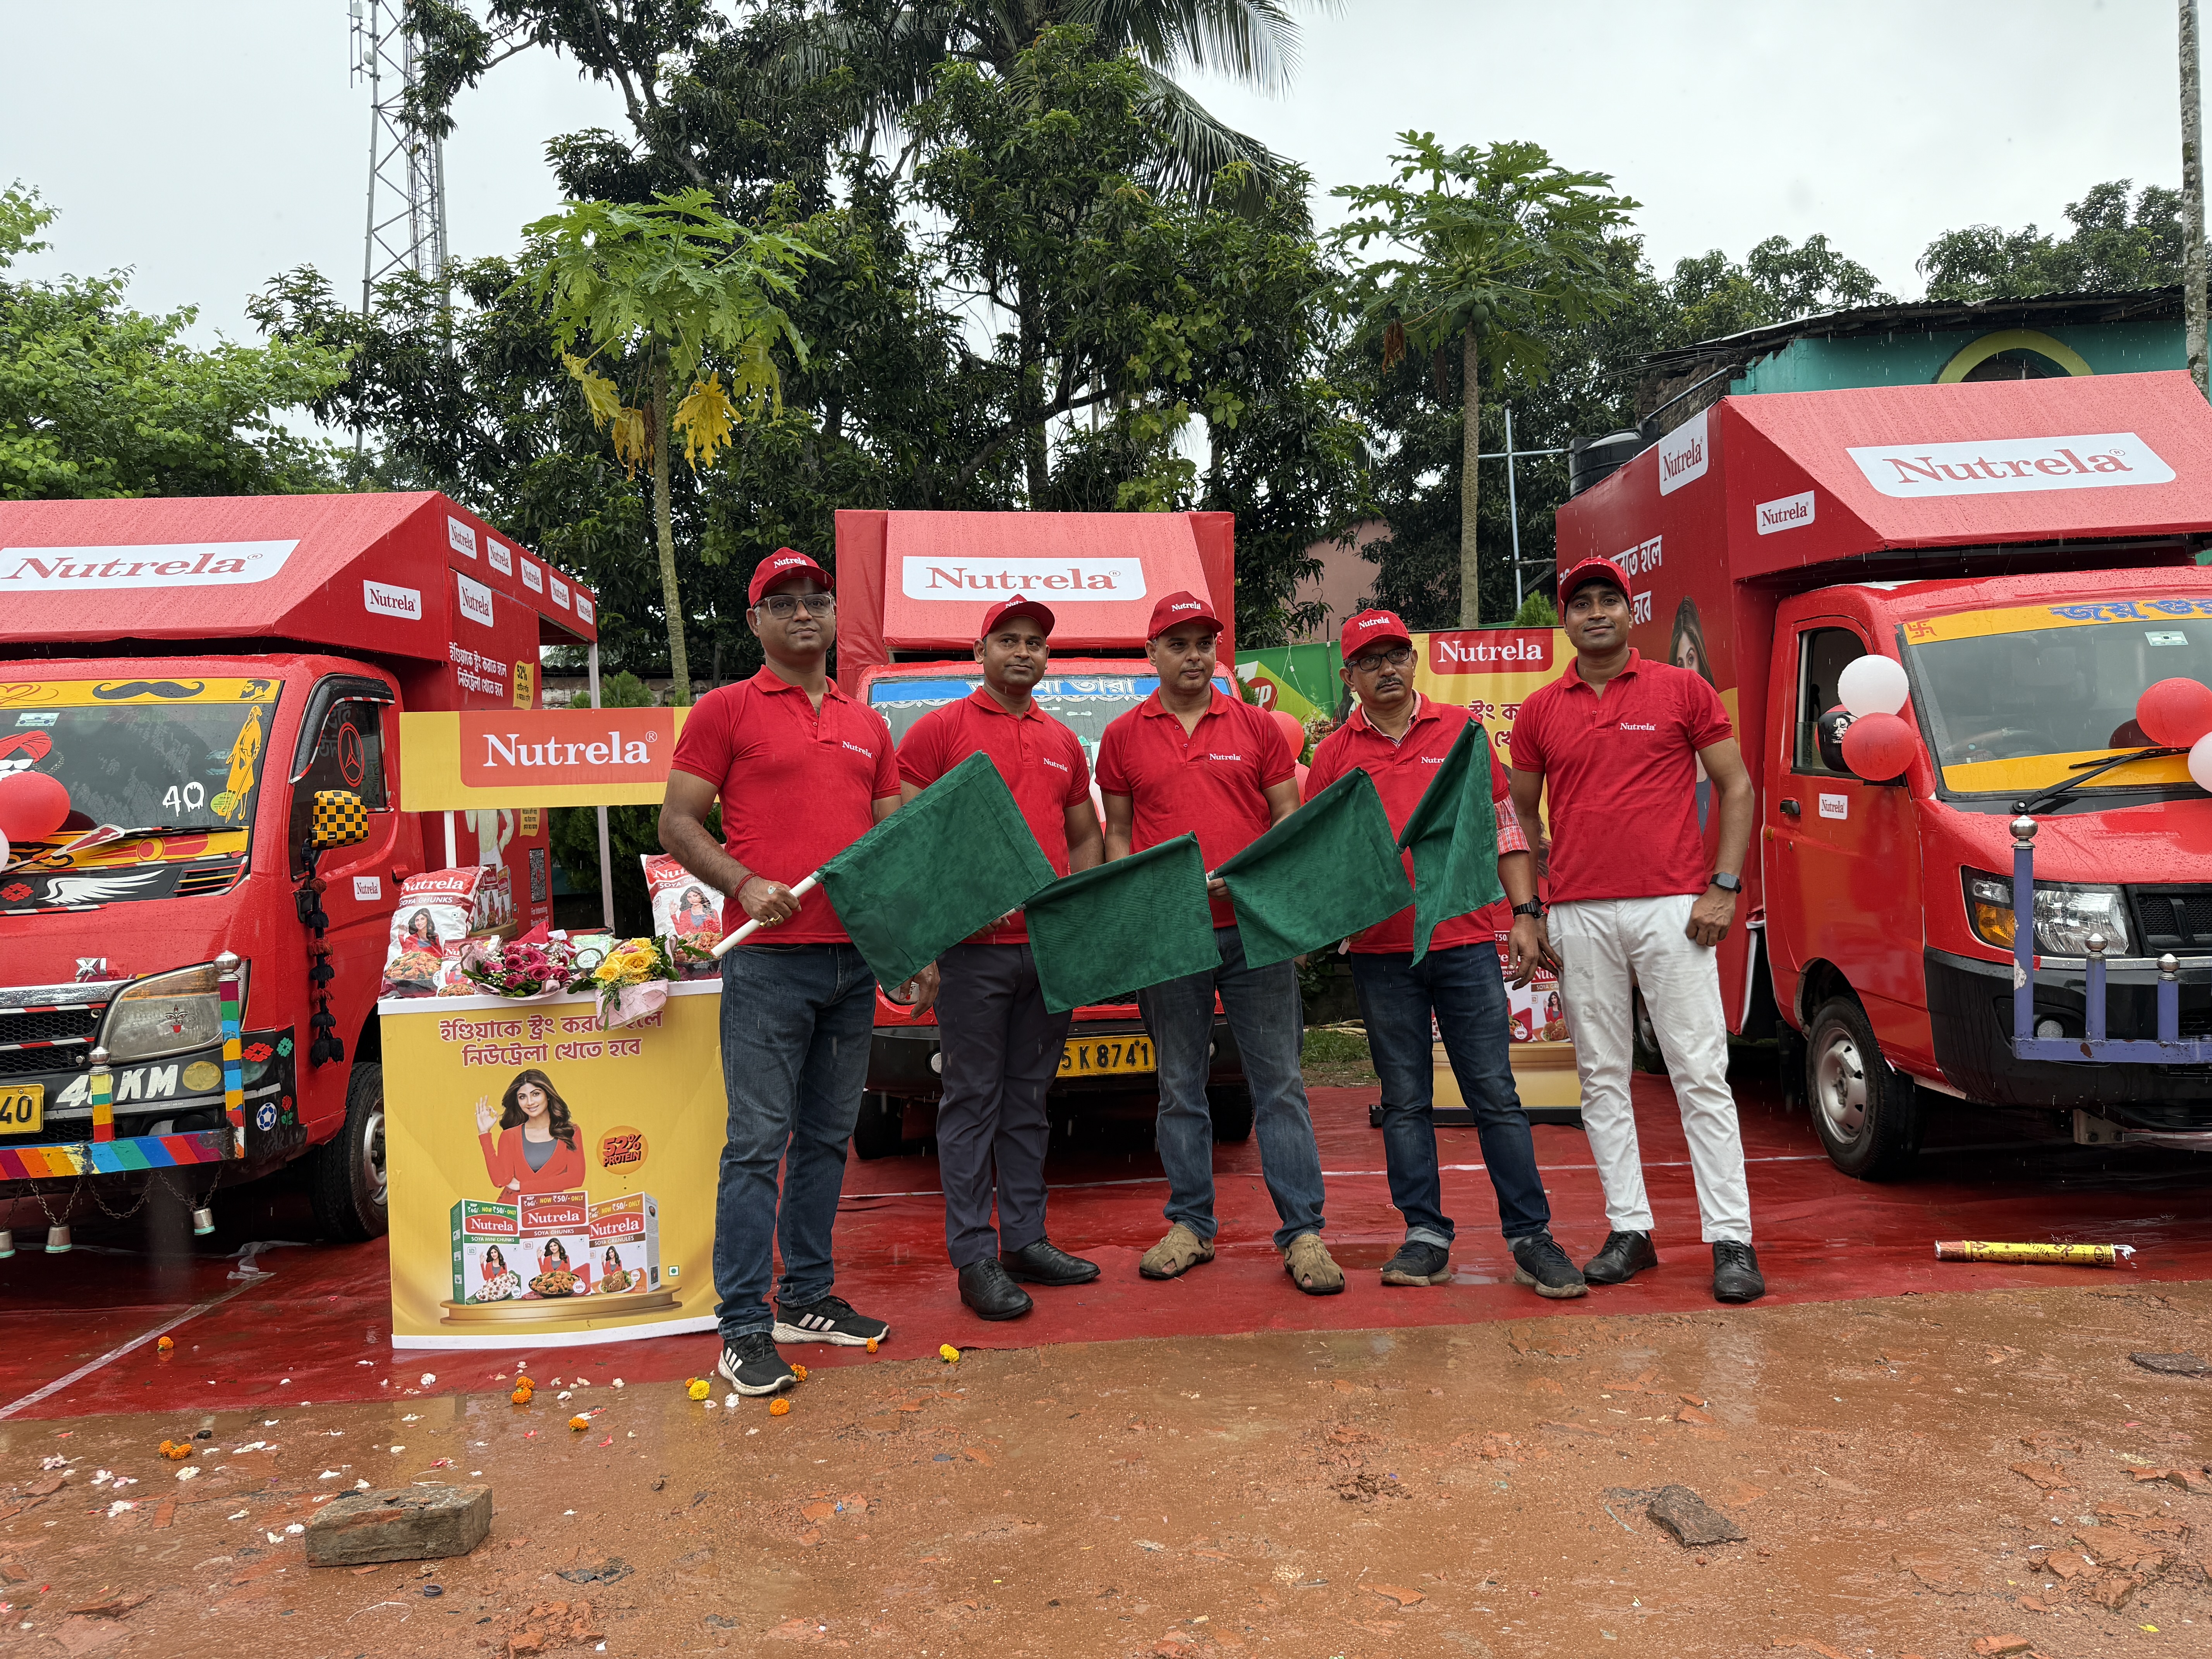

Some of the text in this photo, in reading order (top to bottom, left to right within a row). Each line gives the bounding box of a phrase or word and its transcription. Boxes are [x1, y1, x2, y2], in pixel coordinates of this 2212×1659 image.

[1663, 437, 1702, 481] Nutrela
[1762, 502, 1808, 526] Nutrela
[451, 525, 473, 551] Nutrela
[489, 545, 509, 568] Nutrela
[773, 557, 807, 568] Nutrela
[1640, 534, 1662, 572] হলে
[524, 565, 540, 586] Nutrela
[369, 588, 416, 612] Nutrela
[462, 587, 489, 617] Nutrela
[552, 583, 568, 603] Nutrela
[579, 600, 591, 618] Nutrela
[1171, 601, 1201, 611] Nutrela
[1633, 591, 1651, 625] হবে
[1358, 617, 1390, 630] Nutrela
[1437, 638, 1543, 662] Nutrela
[517, 665, 527, 681] 52%
[1065, 678, 1136, 694] তারা
[1620, 723, 1656, 731] Nutrela
[842, 740, 872, 758] Nutrela
[1043, 757, 1068, 772] Nutrela
[162, 781, 204, 817] 40
[1821, 799, 1844, 813] Nutrela
[356, 882, 378, 894] Nutrela
[462, 1038, 642, 1066] নিউট্রেলা খেতে হবে
[1097, 1043, 1148, 1068] 8741
[117, 1064, 179, 1101] KM
[603, 1133, 642, 1158] 52%
[603, 1151, 642, 1167] PROTEIN
[553, 1195, 570, 1203] ₹50/-
[629, 1199, 641, 1208] ONLY
[471, 1218, 514, 1231] Nutrela
[527, 1210, 580, 1224] Nutrela
[590, 1217, 640, 1237] Nutrela
[608, 1235, 635, 1244] GRANULES
